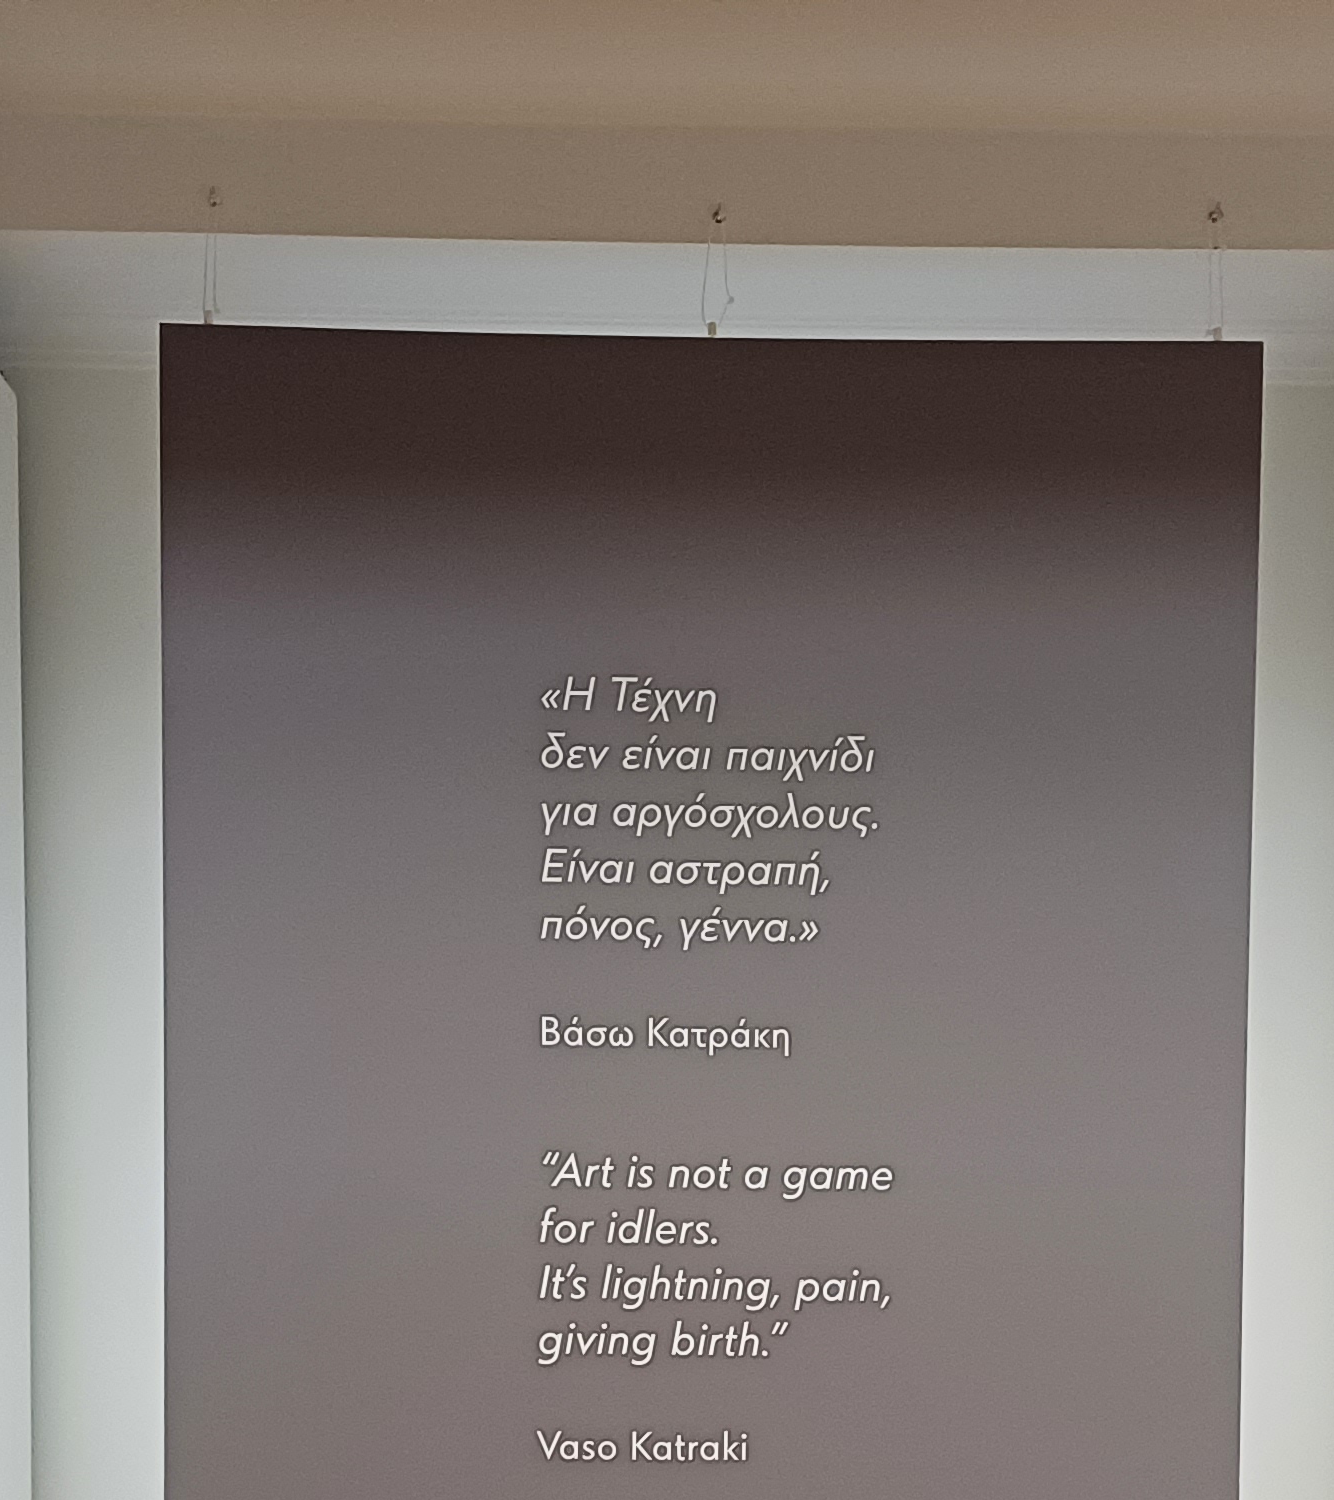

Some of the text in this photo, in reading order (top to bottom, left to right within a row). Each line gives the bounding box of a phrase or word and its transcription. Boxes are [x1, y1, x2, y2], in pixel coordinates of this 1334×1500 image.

[612, 677, 716, 722] Τέχνη
[542, 732, 874, 781] δεν είναι παιχνίδι
[542, 793, 877, 838] για αργόσχολους.
[542, 849, 829, 895] Είναι αστραπή,
[541, 906, 662, 948] πόνος,
[542, 1017, 789, 1056] Βάσω Κατράκη
[628, 1156, 653, 1187] is
[669, 1159, 731, 1188] not
[745, 1167, 768, 1189] a
[783, 1167, 892, 1199] game
[540, 1207, 717, 1244] for idlers.
[602, 1264, 779, 1310] lightning,
[795, 1270, 889, 1310] pain,
[539, 1323, 655, 1365] giving
[537, 1431, 747, 1461] Vaso Katraki
